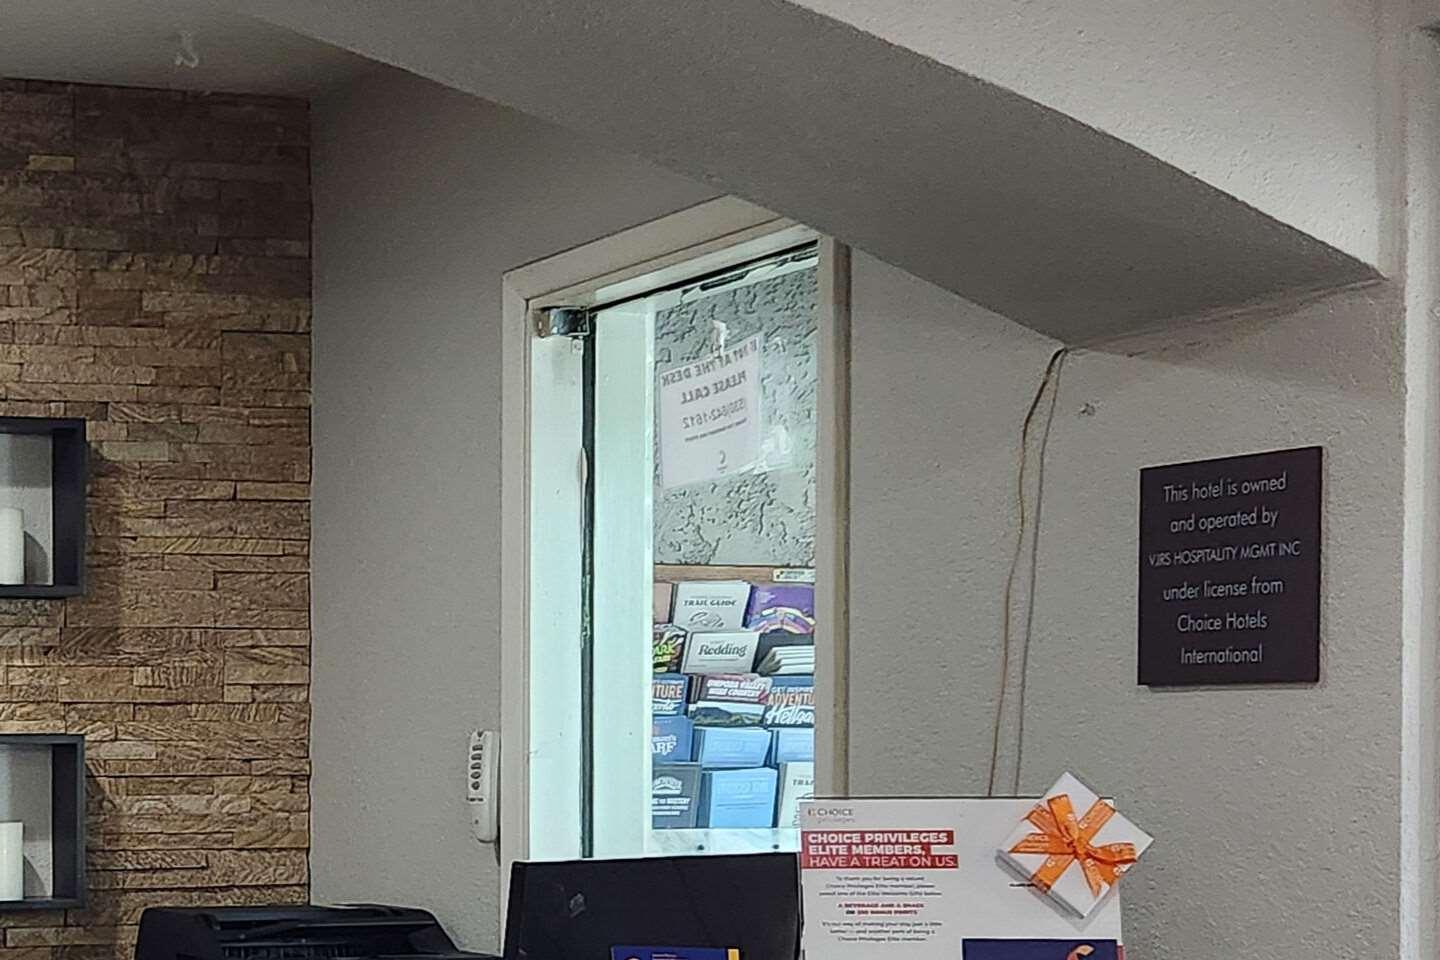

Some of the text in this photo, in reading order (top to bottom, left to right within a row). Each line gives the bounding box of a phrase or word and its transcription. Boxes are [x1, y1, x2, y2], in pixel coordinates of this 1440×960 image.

[1163, 472, 1287, 503] This hotel is owned
[1170, 506, 1279, 534] and operated by
[1174, 547, 1237, 566] HOSPITALITY
[1240, 543, 1277, 561] MGMT
[1278, 540, 1302, 557] INC
[1163, 576, 1284, 601] under license from
[1177, 610, 1268, 632] Choice Hotels
[698, 643, 748, 658] Redding
[1180, 645, 1263, 665] International
[817, 808, 854, 817] CHOICE
[808, 831, 948, 844] CHOICE PRIVILEGES
[808, 844, 926, 857] ELITE MEMBERS,
[810, 856, 957, 867] HAVE A TREAT ON US.
